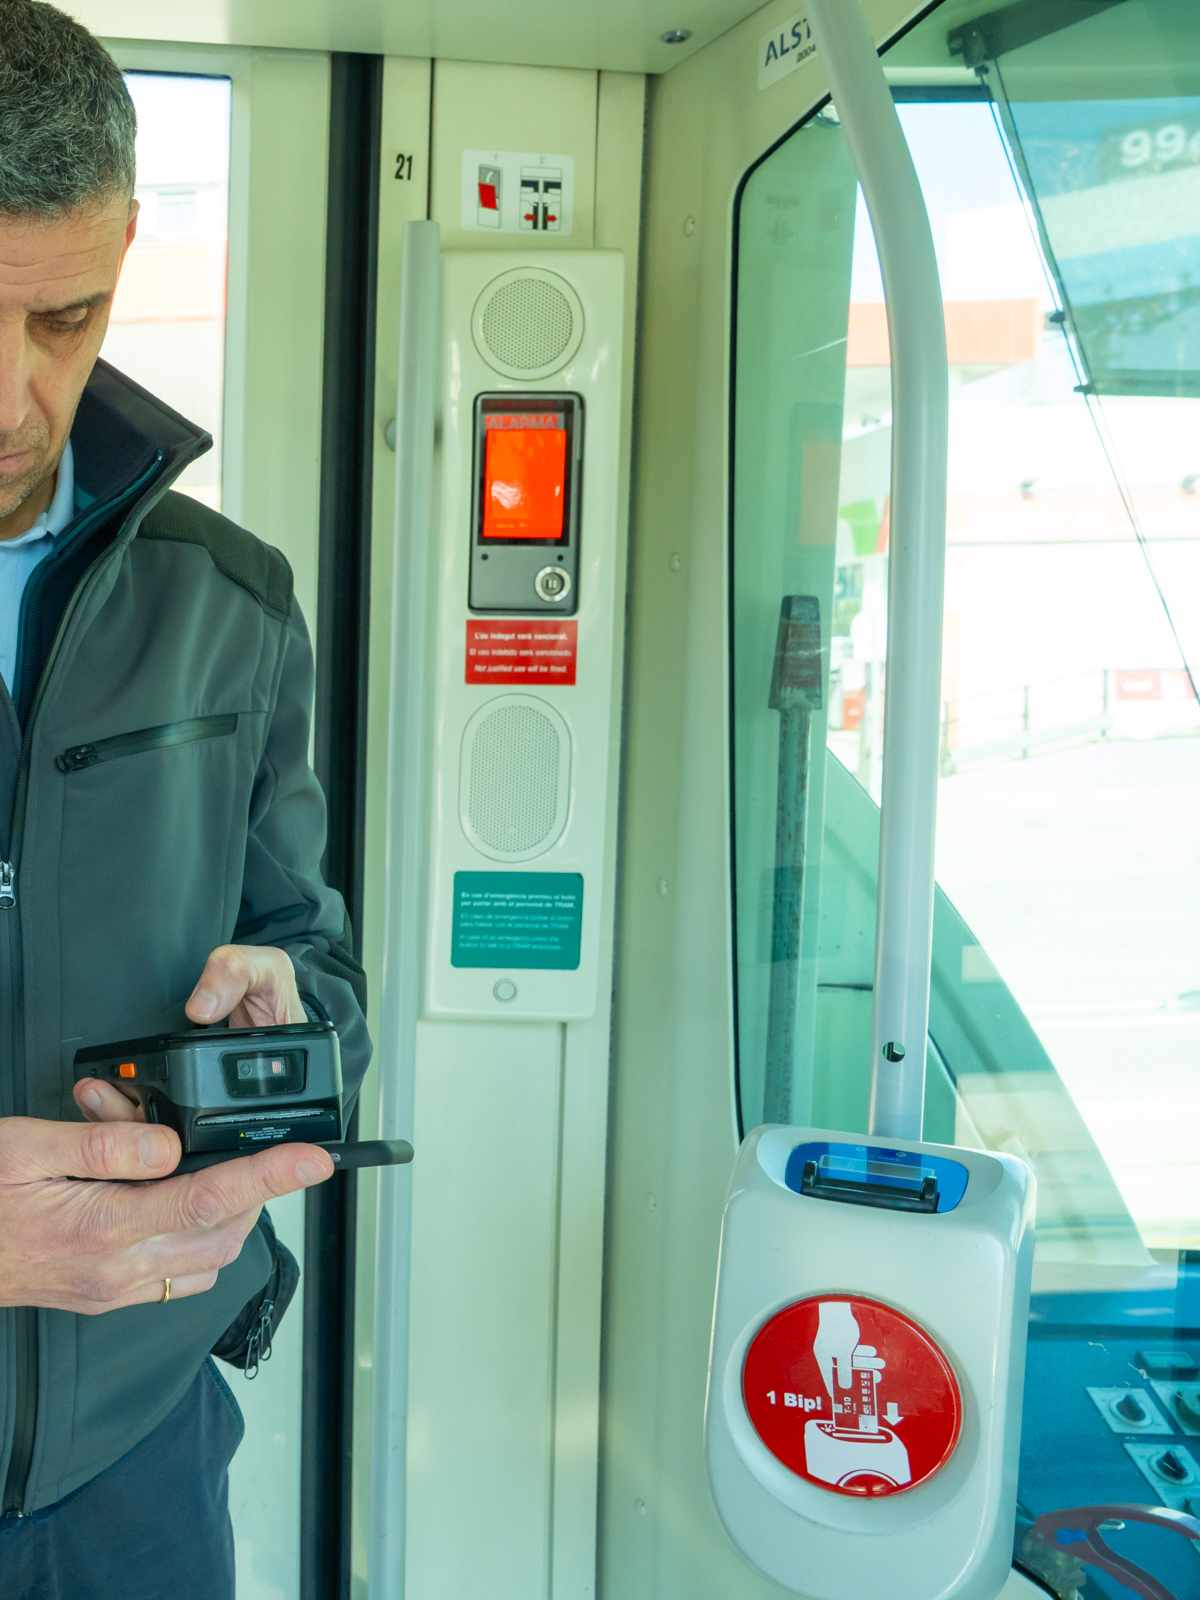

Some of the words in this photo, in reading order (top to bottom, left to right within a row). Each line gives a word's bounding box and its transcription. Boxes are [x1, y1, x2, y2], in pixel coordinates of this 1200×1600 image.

[764, 17, 811, 67] ALST
[1120, 124, 1200, 168] 99
[394, 153, 412, 181] 21
[487, 416, 556, 430] ALARMA
[766, 1390, 776, 1405] 1
[784, 1392, 822, 1413] Bip!
[843, 1396, 852, 1414] T-10
